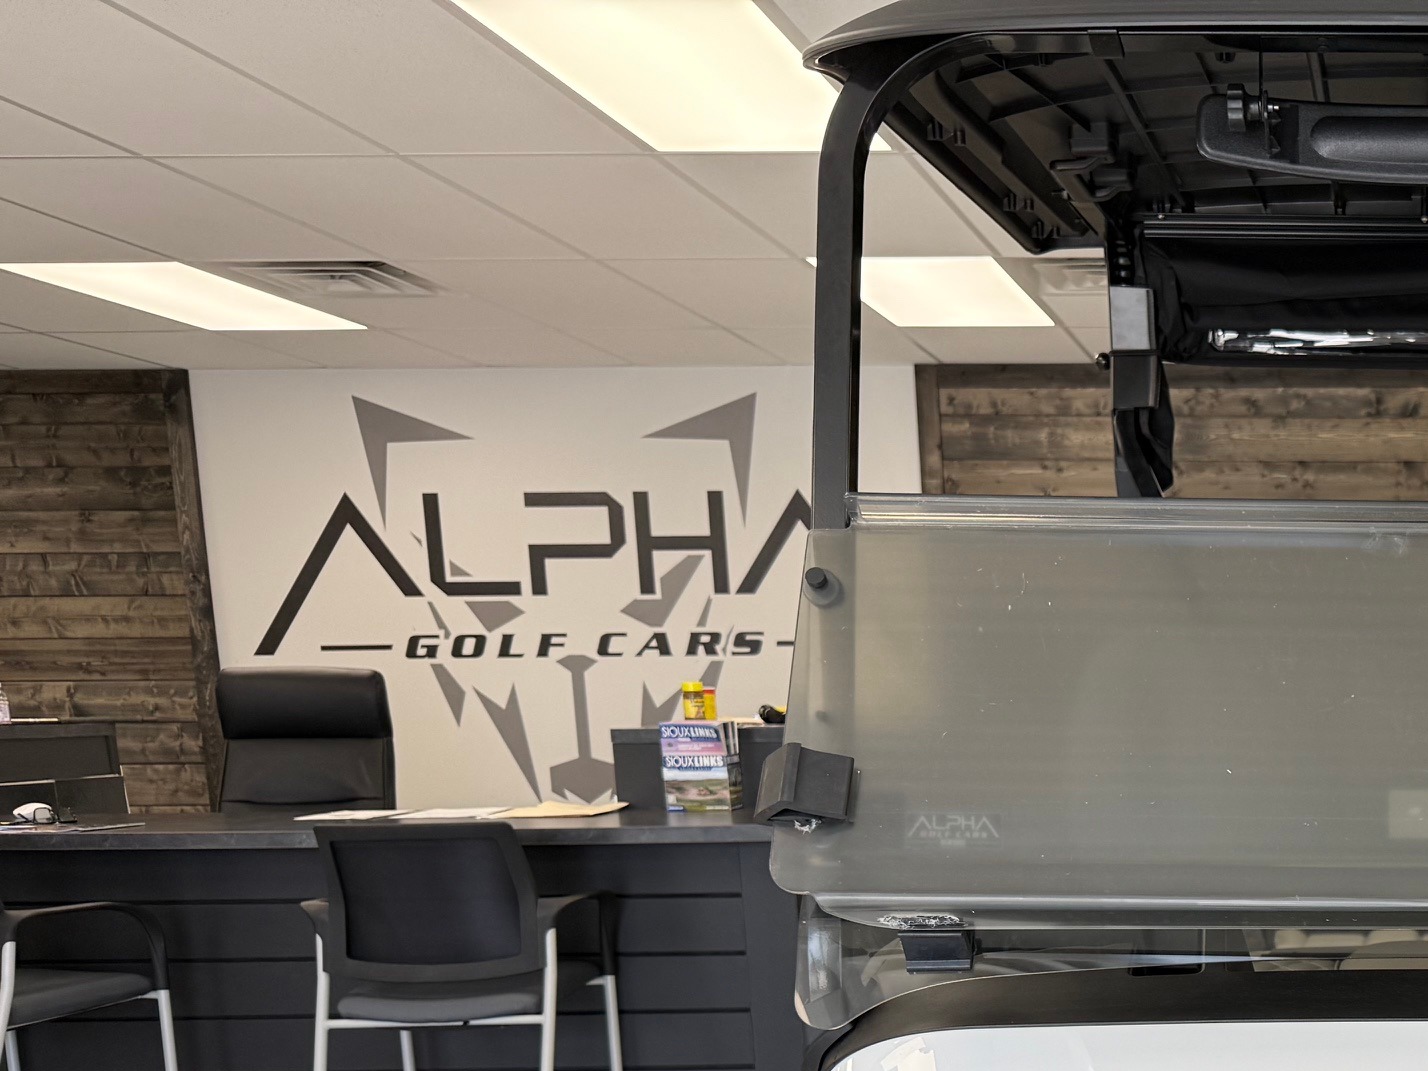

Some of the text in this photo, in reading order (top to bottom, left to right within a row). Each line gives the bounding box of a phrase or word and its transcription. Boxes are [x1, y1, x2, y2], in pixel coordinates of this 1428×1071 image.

[254, 489, 812, 656] ALPHA
[404, 631, 765, 660] GOLF CARS
[907, 815, 999, 838] ALPHA
